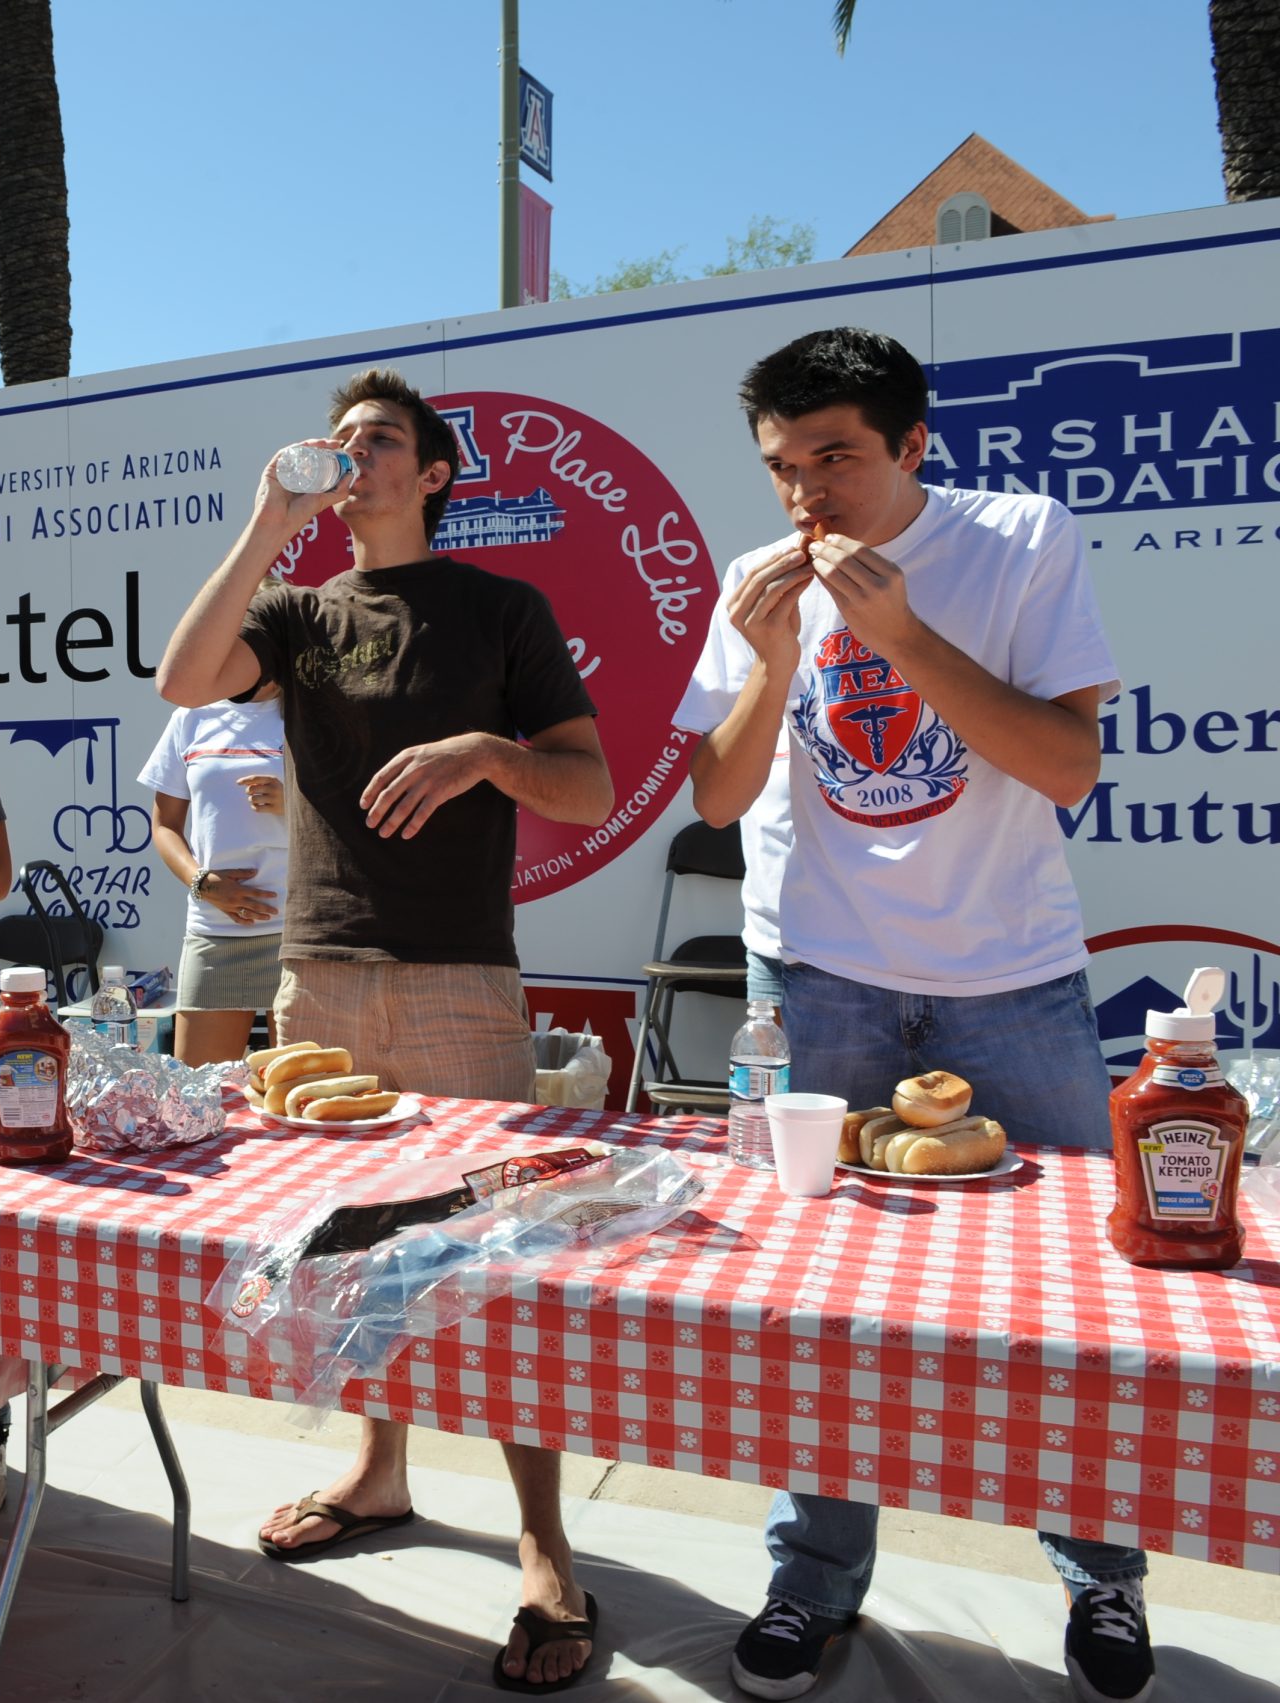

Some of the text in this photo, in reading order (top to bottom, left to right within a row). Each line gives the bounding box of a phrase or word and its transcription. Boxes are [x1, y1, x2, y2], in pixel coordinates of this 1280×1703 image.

[923, 401, 1280, 470] ARSHA
[500, 410, 702, 645] Place Like
[1133, 525, 1280, 551] ARIZ
[1098, 685, 1280, 755] iber
[582, 746, 680, 855] HOMECOMING
[857, 784, 914, 808] 2008
[1163, 1131, 1207, 1145] HEINZ
[1158, 1166, 1213, 1178] KETCHUP
[1161, 1155, 1210, 1166] TOMATO
